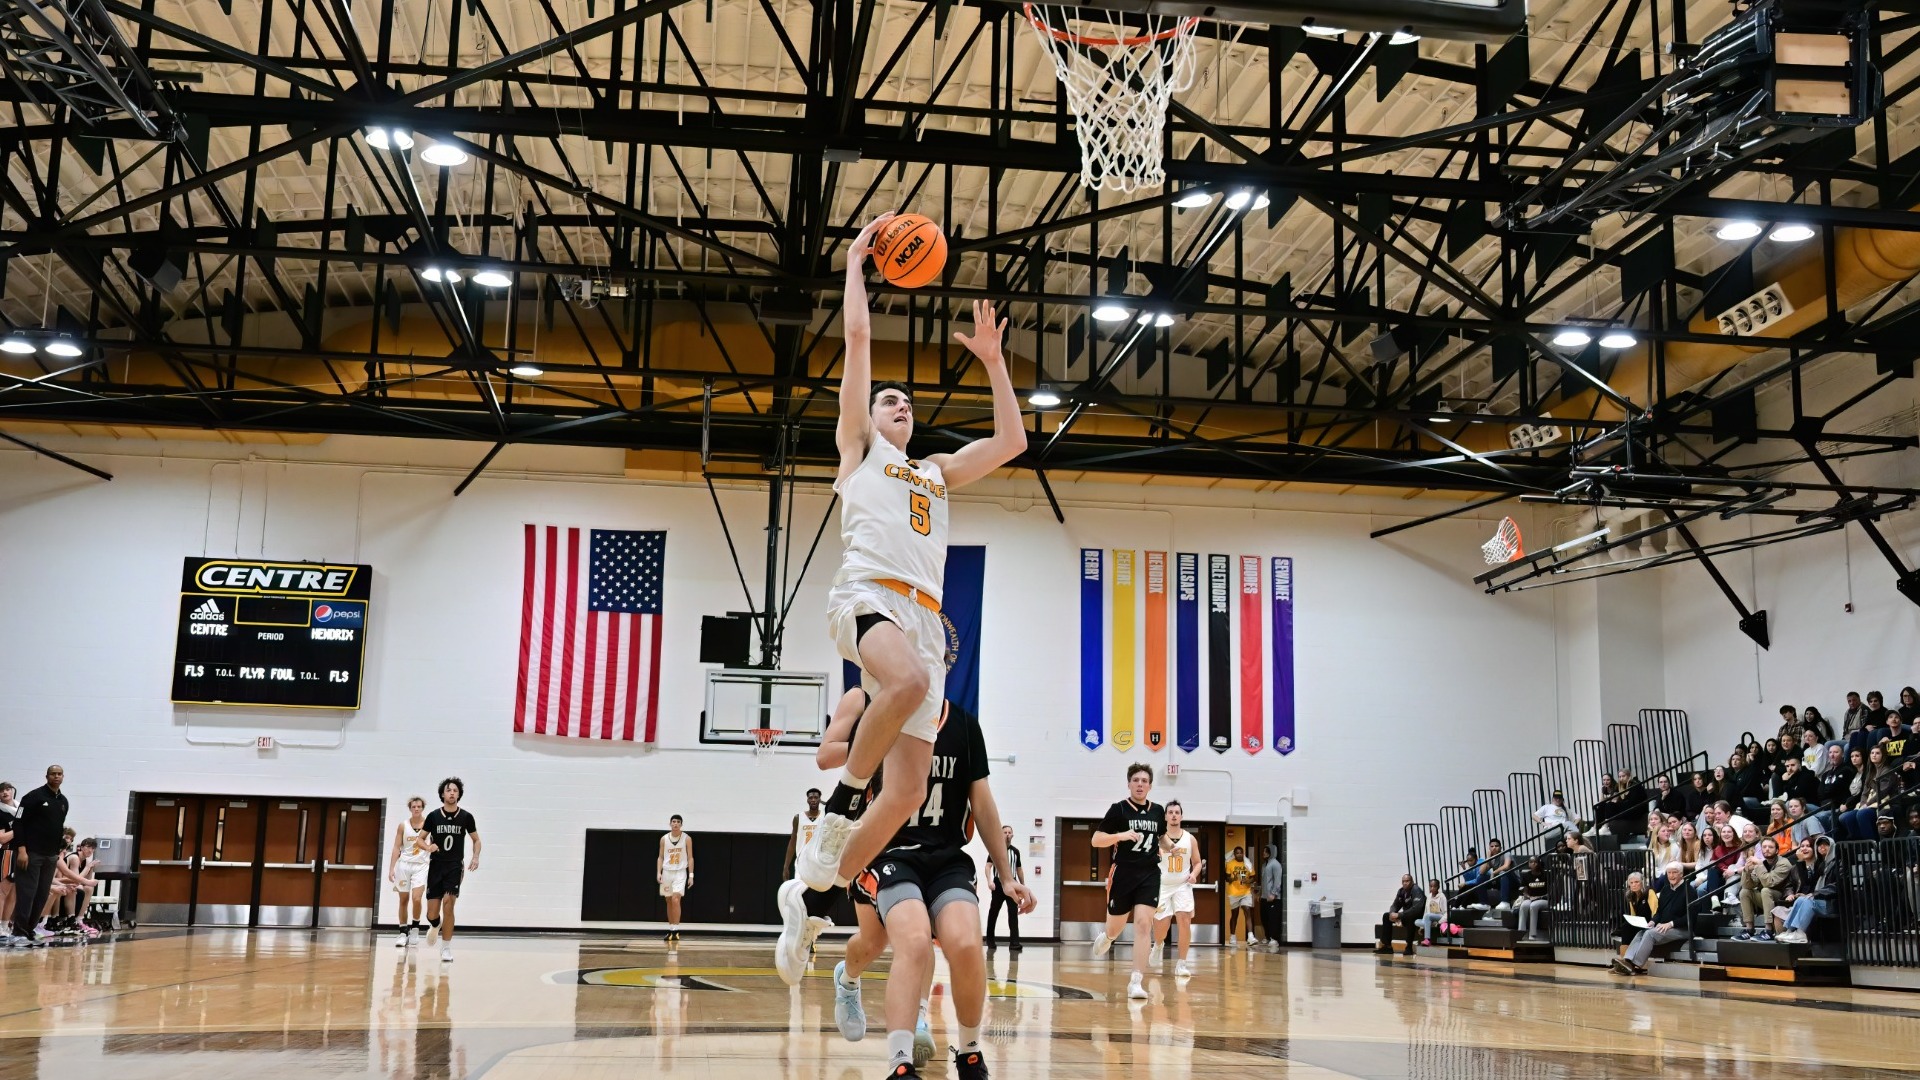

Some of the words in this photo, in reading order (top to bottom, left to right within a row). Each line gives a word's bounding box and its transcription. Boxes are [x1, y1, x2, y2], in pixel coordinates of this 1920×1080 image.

[877, 219, 915, 256] Wilson
[895, 235, 925, 267] NCAA
[884, 463, 946, 500] CENTRE
[909, 489, 931, 537] 5
[1084, 550, 1099, 580] BERRY
[1149, 553, 1163, 594] HENDRIX
[201, 566, 348, 591] CENTRE
[1180, 554, 1195, 601] MILLSAPS
[1211, 556, 1227, 614] OGLETHORPE
[1243, 557, 1258, 594] RHODES
[1274, 558, 1290, 601] SEWANEE
[190, 611, 225, 621] adidas
[333, 610, 361, 620] pepsi
[190, 623, 229, 636] CENTRE
[257, 632, 284, 641] PERIOD
[311, 628, 354, 642] HENDRIX
[184, 665, 204, 677] FLS
[215, 668, 236, 677] T.O.L.
[239, 667, 265, 680] PLYR
[270, 668, 295, 681] FOUL
[300, 671, 320, 680] T.O.L.
[329, 670, 349, 682] FLS
[257, 736, 272, 747] EXIT
[1167, 764, 1179, 774] EXIT
[436, 824, 462, 834] HENDRIX
[1128, 819, 1158, 833] HENDRIX
[443, 835, 454, 851] 0
[1132, 833, 1154, 853] 24
[1167, 855, 1183, 873] 10
